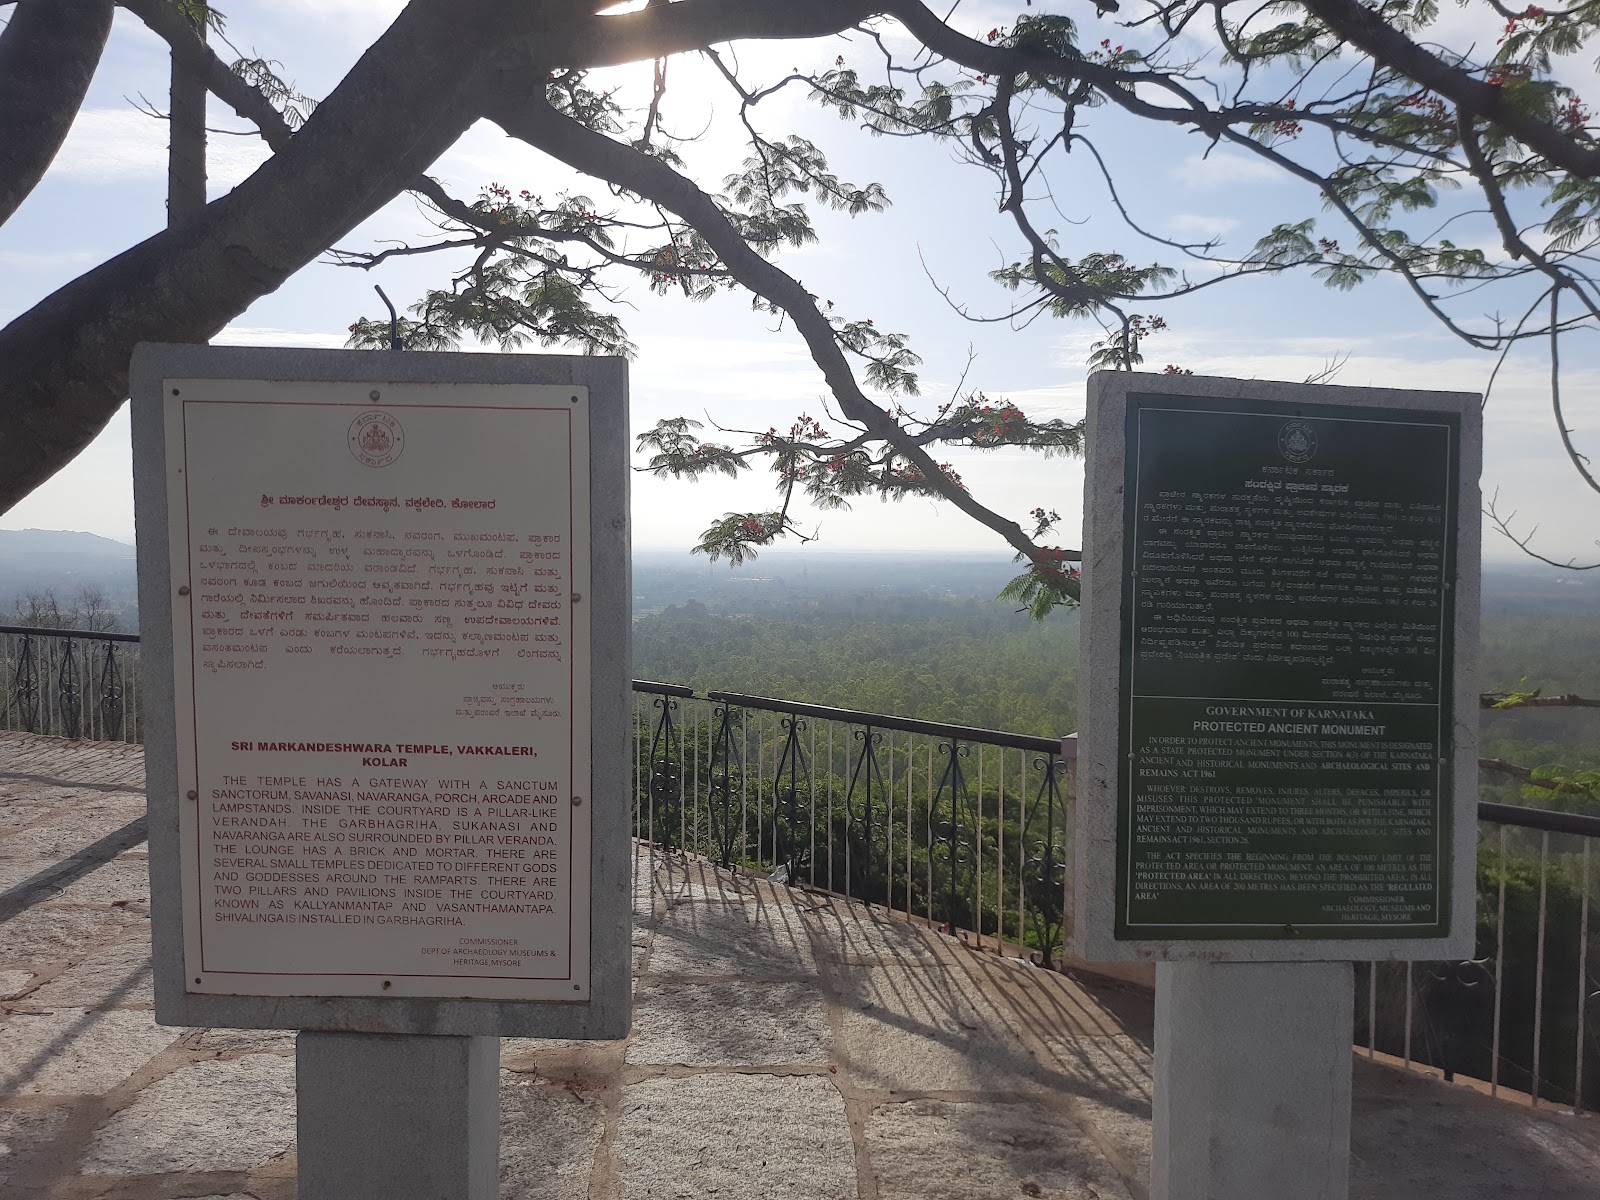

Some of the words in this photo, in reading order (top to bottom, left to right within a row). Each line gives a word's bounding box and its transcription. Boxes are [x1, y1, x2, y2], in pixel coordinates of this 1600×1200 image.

[1205, 706, 1288, 717] GOVERNMENT
[1290, 708, 1306, 718] OF
[1308, 709, 1375, 719] KARNATAKA
[1193, 721, 1265, 732] PROTECTED
[1267, 723, 1319, 734] ANCIENT
[1321, 724, 1386, 735] MONUMENT
[231, 741, 253, 751] SRI
[257, 741, 392, 754] MARKANDESHWARA
[362, 757, 407, 767] KOLAR
[222, 775, 247, 785] THE
[257, 776, 307, 787] TEMPLE
[317, 777, 342, 787] HAS
[351, 777, 360, 787] A
[369, 778, 428, 788] GATEWAY
[438, 779, 469, 789] WITH
[479, 780, 488, 789] A
[497, 780, 557, 791] SANCTUM
[481, 793, 531, 804] ARCADE
[532, 794, 558, 804] AND
[301, 804, 340, 814] INSIDE
[347, 805, 370, 815] THE
[377, 805, 450, 817] COURTYARD
[457, 807, 468, 817] IS
[473, 807, 482, 817] A
[488, 807, 557, 818] PILLAR-LIKE
[302, 818, 327, 828] THE
[452, 820, 520, 831] SUKANASI
[530, 822, 557, 832] AND
[213, 830, 285, 841] NAVARANGA
[287, 831, 311, 841] ARE
[313, 832, 345, 842] ALSO
[348, 832, 432, 844] SURROUNDED
[435, 834, 451, 844] BY
[454, 834, 494, 845] PILLAR
[213, 844, 237, 854] THE
[245, 844, 294, 855] LOUNGE
[303, 845, 327, 855] HAS
[334, 846, 342, 855] A
[349, 846, 385, 856] BRICK
[392, 847, 417, 857] AND
[486, 848, 525, 859] THERE
[532, 849, 557, 859] ARE
[213, 857, 268, 868] SEVERAL
[270, 858, 310, 869] SMALL
[310, 859, 365, 870] TEMPLES
[367, 860, 434, 871] DEDICATED
[436, 861, 453, 871] TO
[455, 861, 520, 873] DIFFERENT
[522, 863, 557, 873] GODS
[213, 871, 238, 881] AND
[245, 871, 320, 883] GODDESSES
[325, 873, 377, 883] AROUND
[383, 874, 406, 884] THE
[487, 876, 526, 886] THERE
[532, 877, 557, 887] ARE
[214, 885, 242, 895] TWO
[249, 886, 297, 896] PILLARS
[303, 886, 329, 896] AND
[336, 886, 396, 898] PAVILIONS
[404, 888, 442, 898] INSIDE
[450, 889, 473, 899] THE
[214, 898, 259, 909] KNOWN
[268, 899, 284, 910] AS
[294, 899, 393, 911] KALLYANMANTAP
[401, 902, 426, 912] AND
[214, 912, 284, 923] SHIVALINGA
[285, 913, 296, 923] IS
[298, 913, 361, 924] INSTALLED
[363, 915, 374, 924] IN
[459, 937, 518, 946] COMMISSIONER
[453, 948, 507, 956] ARCHAEOLOGY
[509, 949, 549, 957] MUSEUMS
